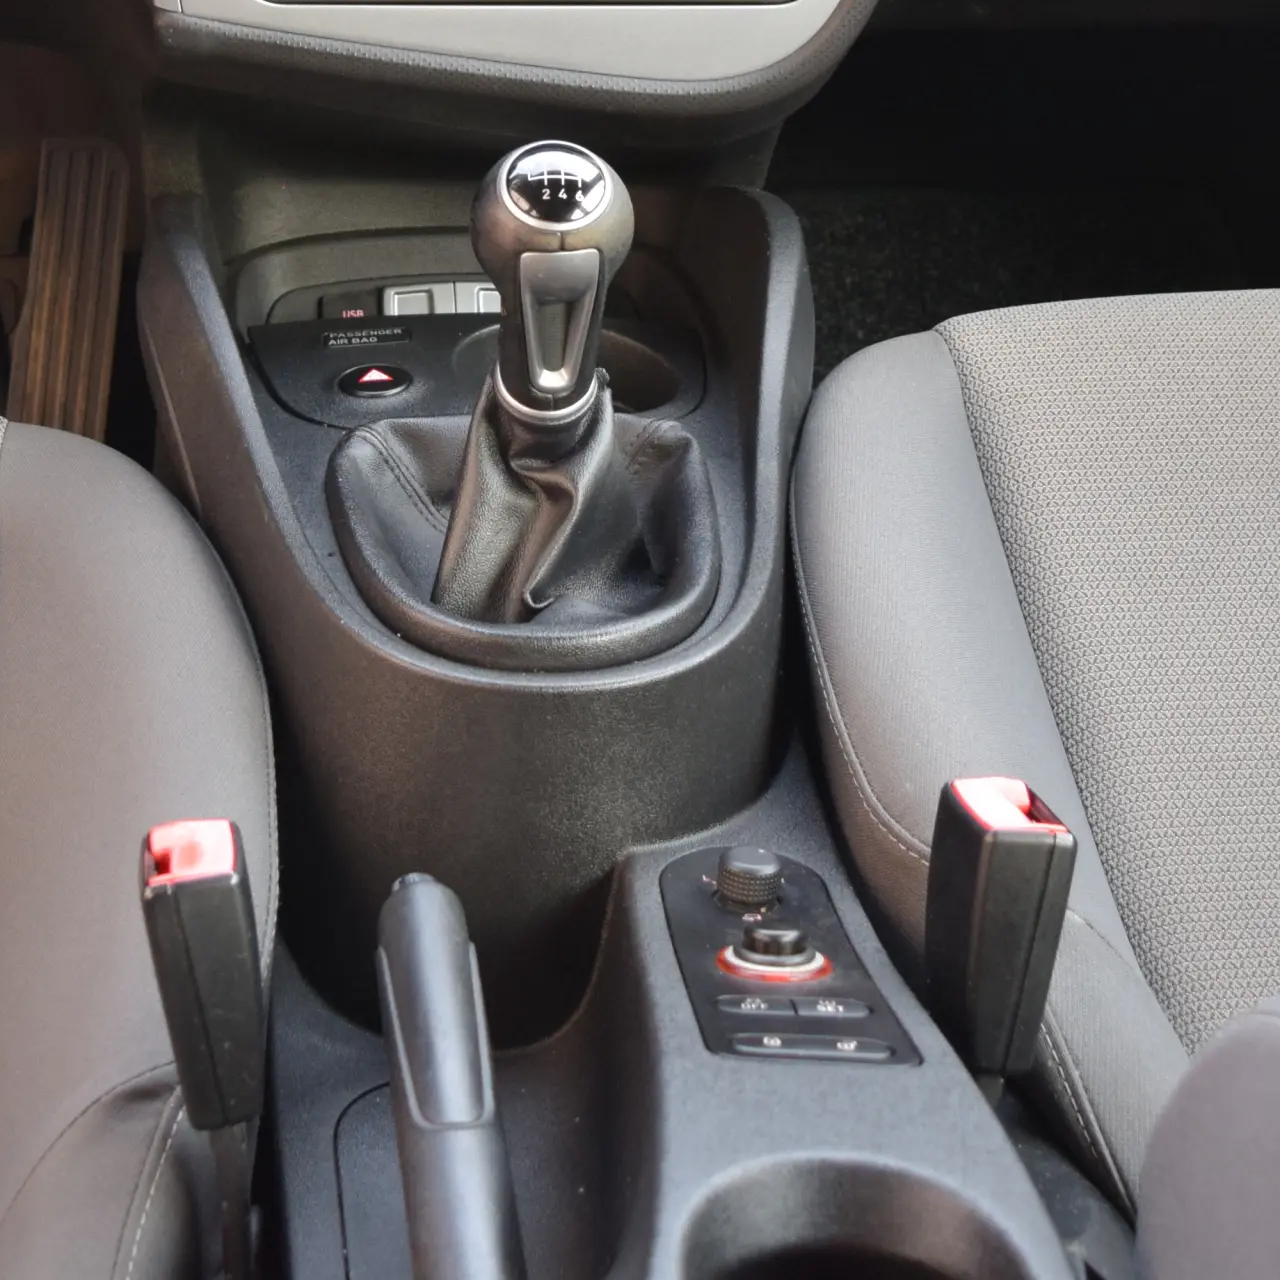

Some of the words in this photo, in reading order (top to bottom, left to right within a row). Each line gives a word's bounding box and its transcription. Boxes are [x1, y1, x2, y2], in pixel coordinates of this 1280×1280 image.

[542, 188, 551, 200] 2
[558, 188, 568, 200] 4
[342, 309, 365, 318] USB
